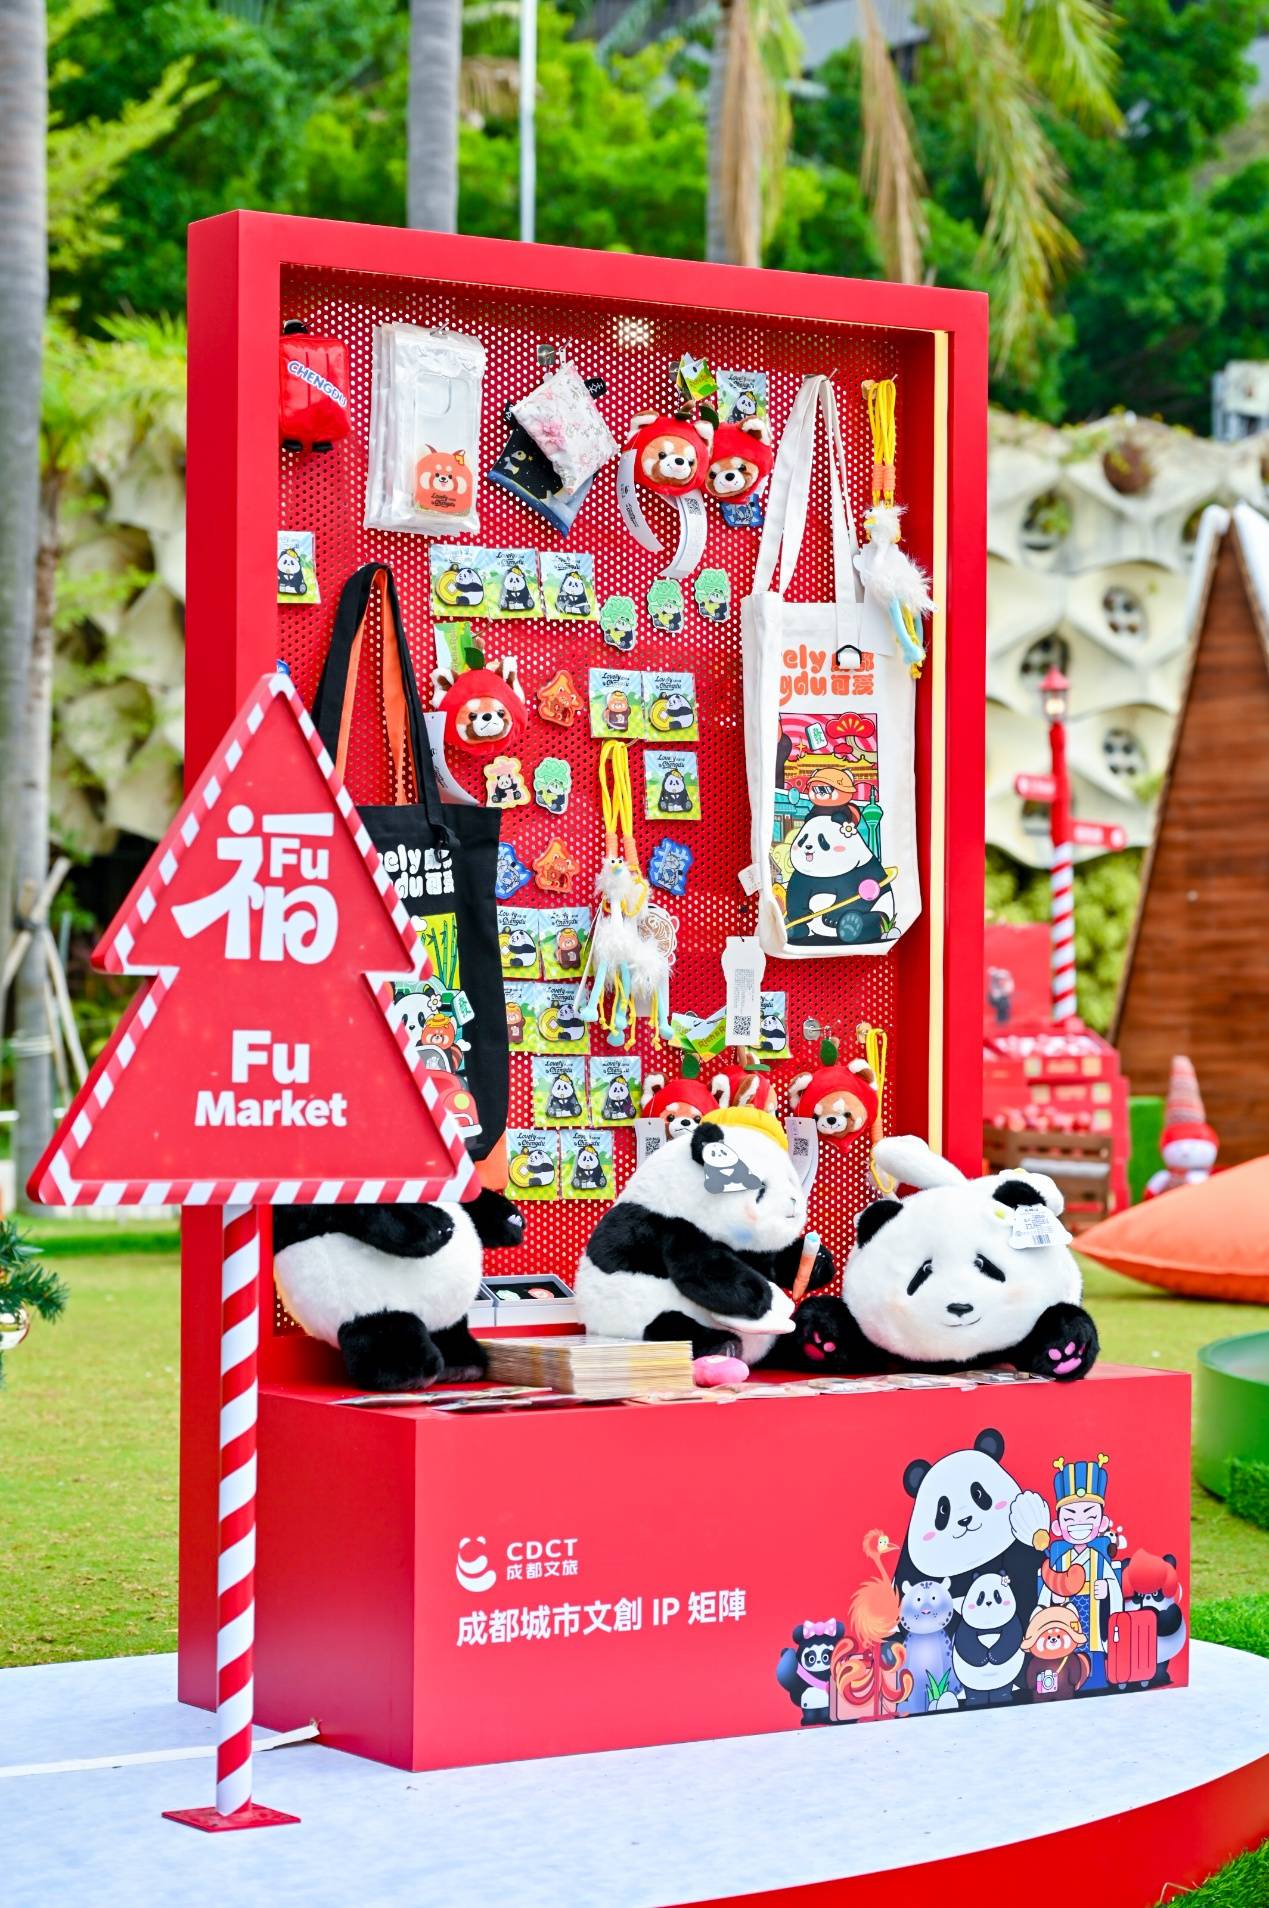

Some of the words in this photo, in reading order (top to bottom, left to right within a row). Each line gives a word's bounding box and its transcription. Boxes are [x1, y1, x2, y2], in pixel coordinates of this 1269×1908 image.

[287, 360, 347, 407] CHENGDU
[269, 837, 329, 880] Fu
[232, 1029, 310, 1084] Fu
[194, 1090, 347, 1127] Market
[506, 1560, 578, 1580] 成都文旅
[507, 1538, 578, 1561] CDCT
[456, 1597, 642, 1647] 成都城市文創
[653, 1597, 680, 1626] IP
[688, 1588, 747, 1625] 矩陣
